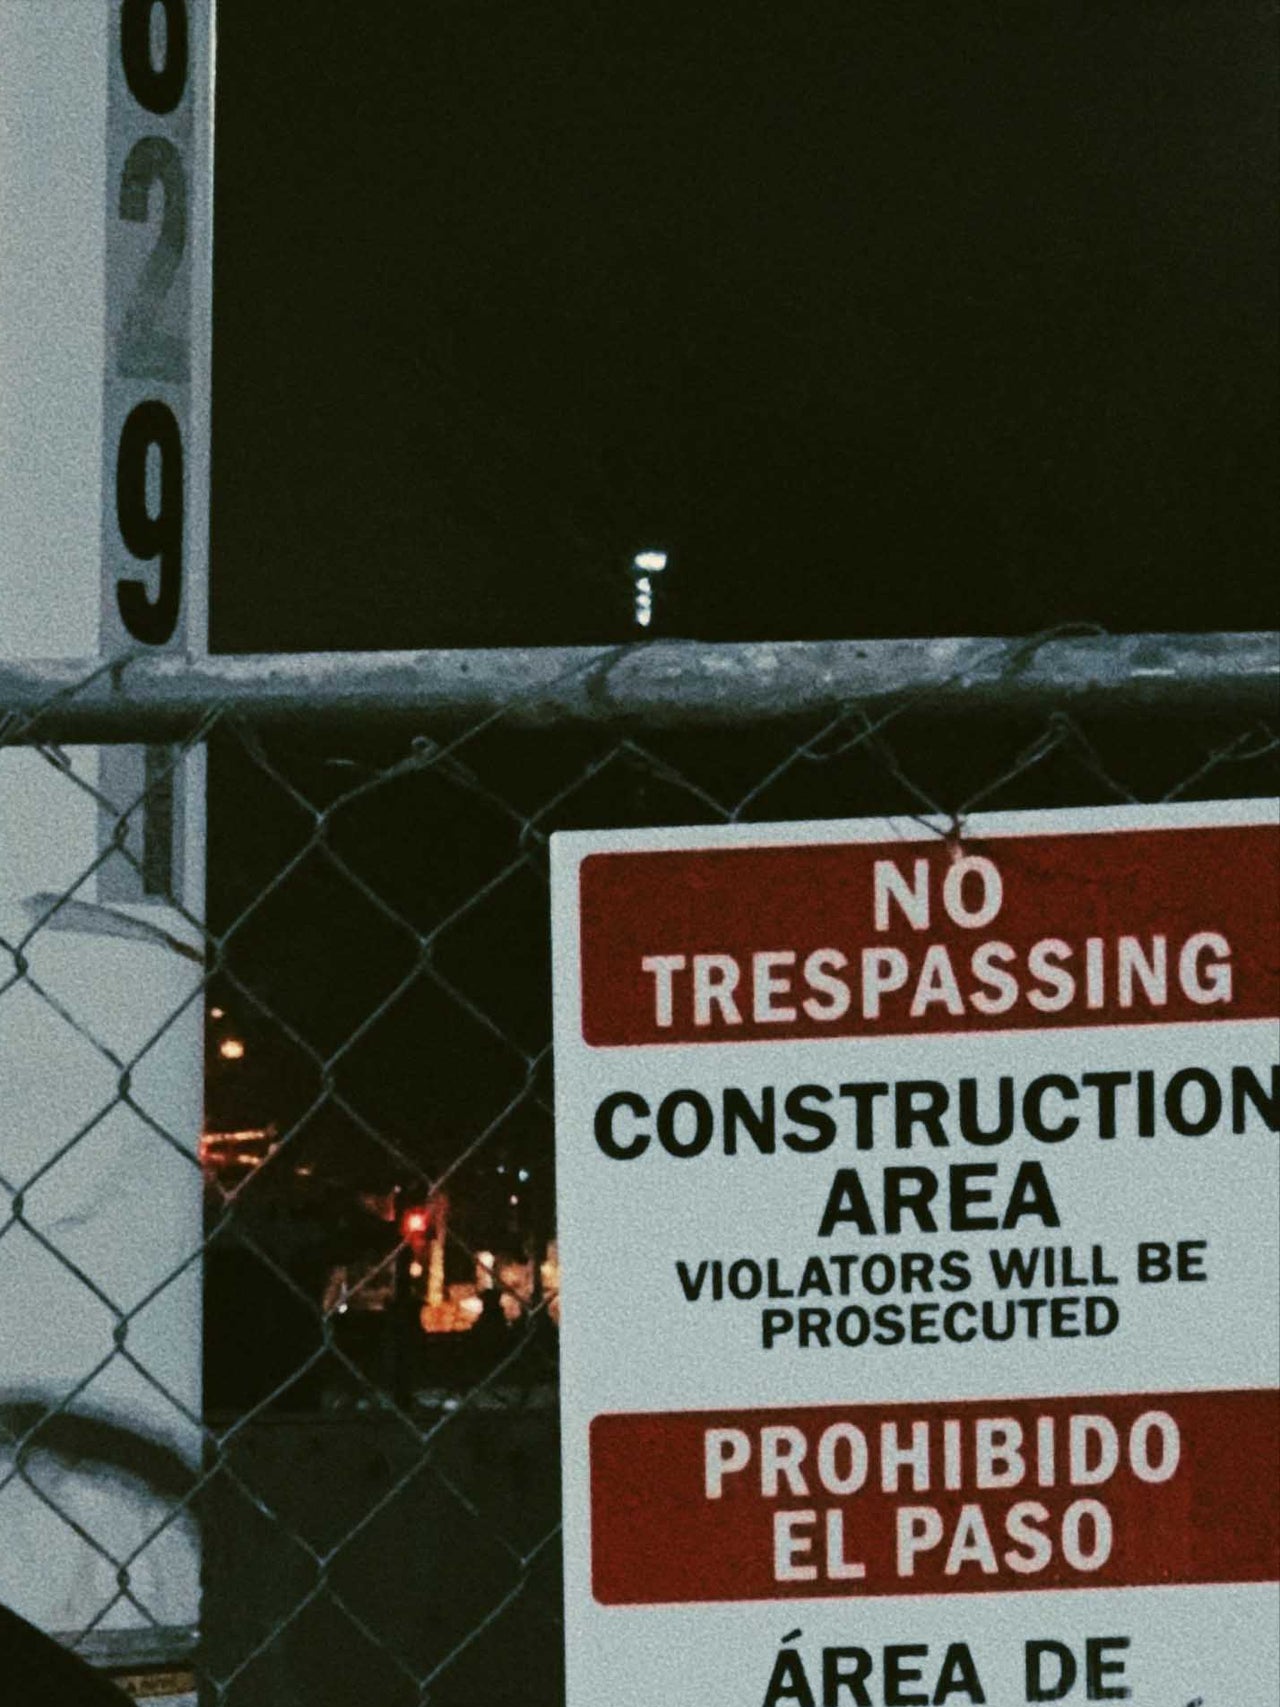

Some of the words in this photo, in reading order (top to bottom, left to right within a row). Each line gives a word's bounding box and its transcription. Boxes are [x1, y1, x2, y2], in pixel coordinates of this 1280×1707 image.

[874, 856, 1003, 932] NO
[641, 931, 1234, 1028] TRESPASSING
[593, 1064, 1280, 1161] CONSTRUCTION
[817, 1160, 1061, 1237] AREA
[675, 1250, 972, 1302] VIOLATORS
[989, 1244, 1119, 1290] WILL
[1137, 1240, 1208, 1284] BE
[761, 1295, 1121, 1350] PROSECUTED
[703, 1410, 1181, 1500] PROHIBIDO
[773, 1508, 866, 1582] EL
[896, 1499, 1114, 1578] PASO
[1024, 1636, 1132, 1703] DE
